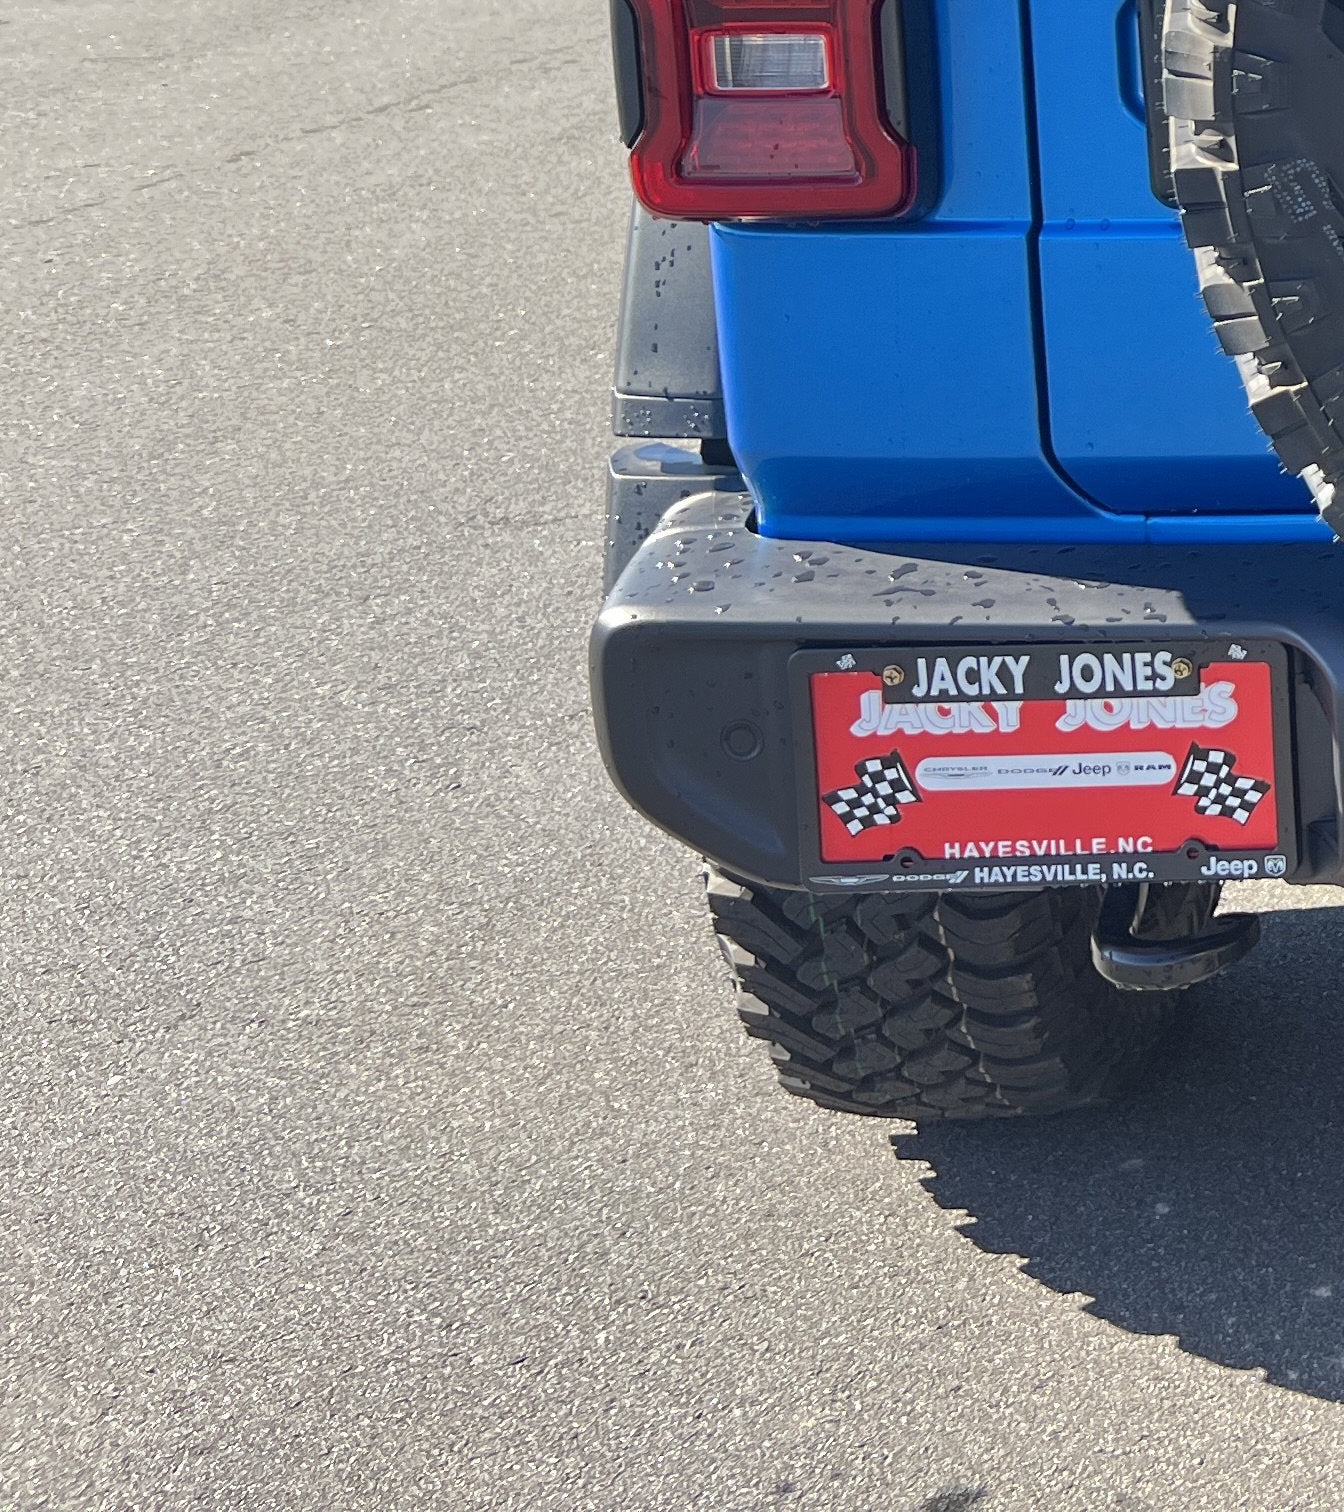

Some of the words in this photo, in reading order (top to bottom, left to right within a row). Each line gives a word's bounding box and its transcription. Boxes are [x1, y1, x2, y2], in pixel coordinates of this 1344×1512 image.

[912, 655, 1030, 698] JACKY
[1054, 651, 1174, 695] JONES
[1072, 762, 1112, 778] Jeep
[1134, 763, 1172, 771] RAM
[974, 863, 1107, 884] HAYESVILLE,
[1112, 861, 1155, 881] N.C.
[1201, 855, 1258, 879] Jeep
